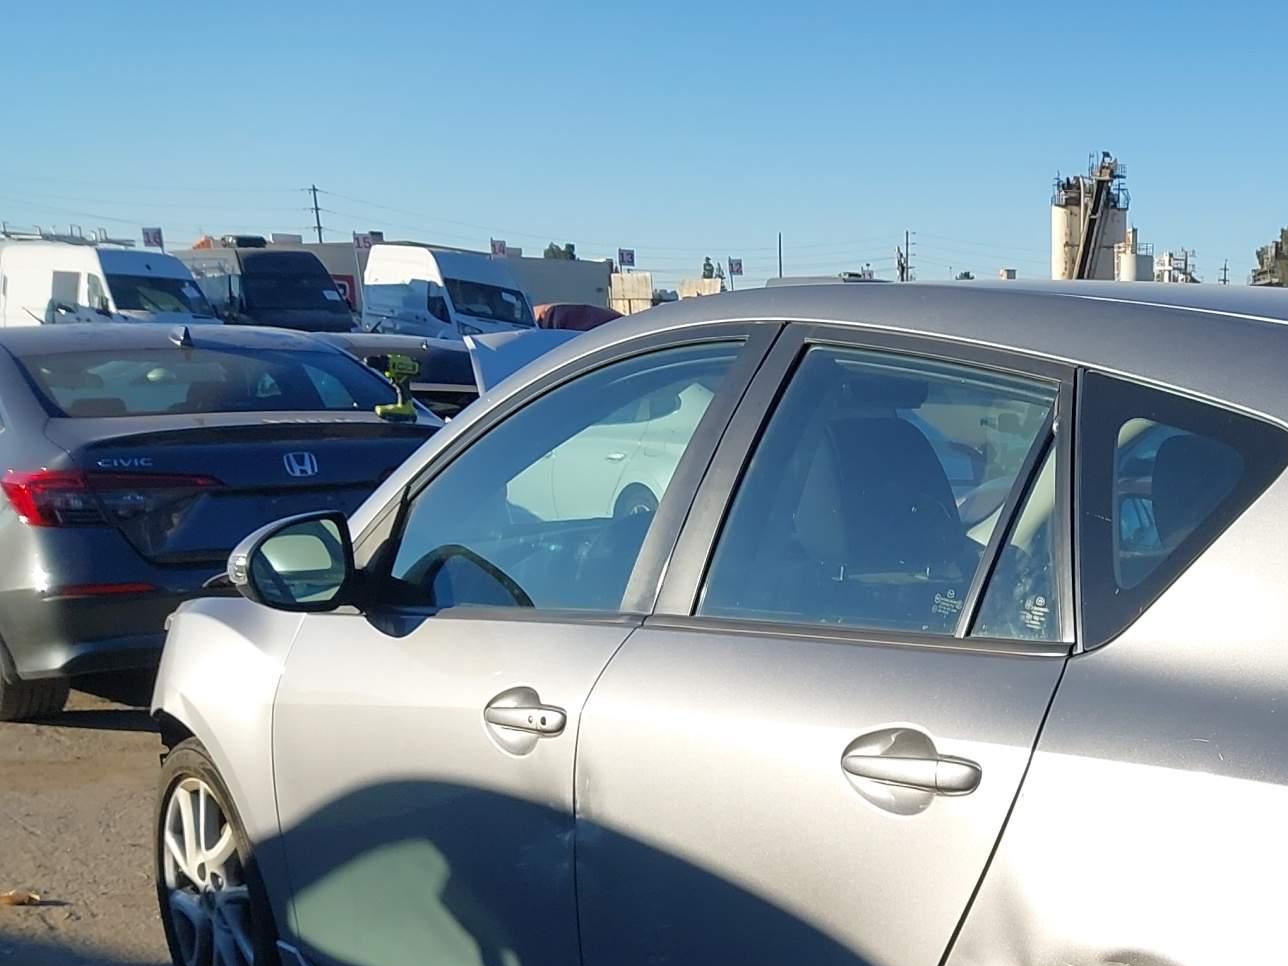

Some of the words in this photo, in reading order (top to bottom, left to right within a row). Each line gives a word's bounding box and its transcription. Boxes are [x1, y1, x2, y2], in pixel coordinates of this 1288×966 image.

[354, 236, 371, 248] 15
[619, 252, 634, 264] 13
[96, 457, 153, 468] CIVIC
